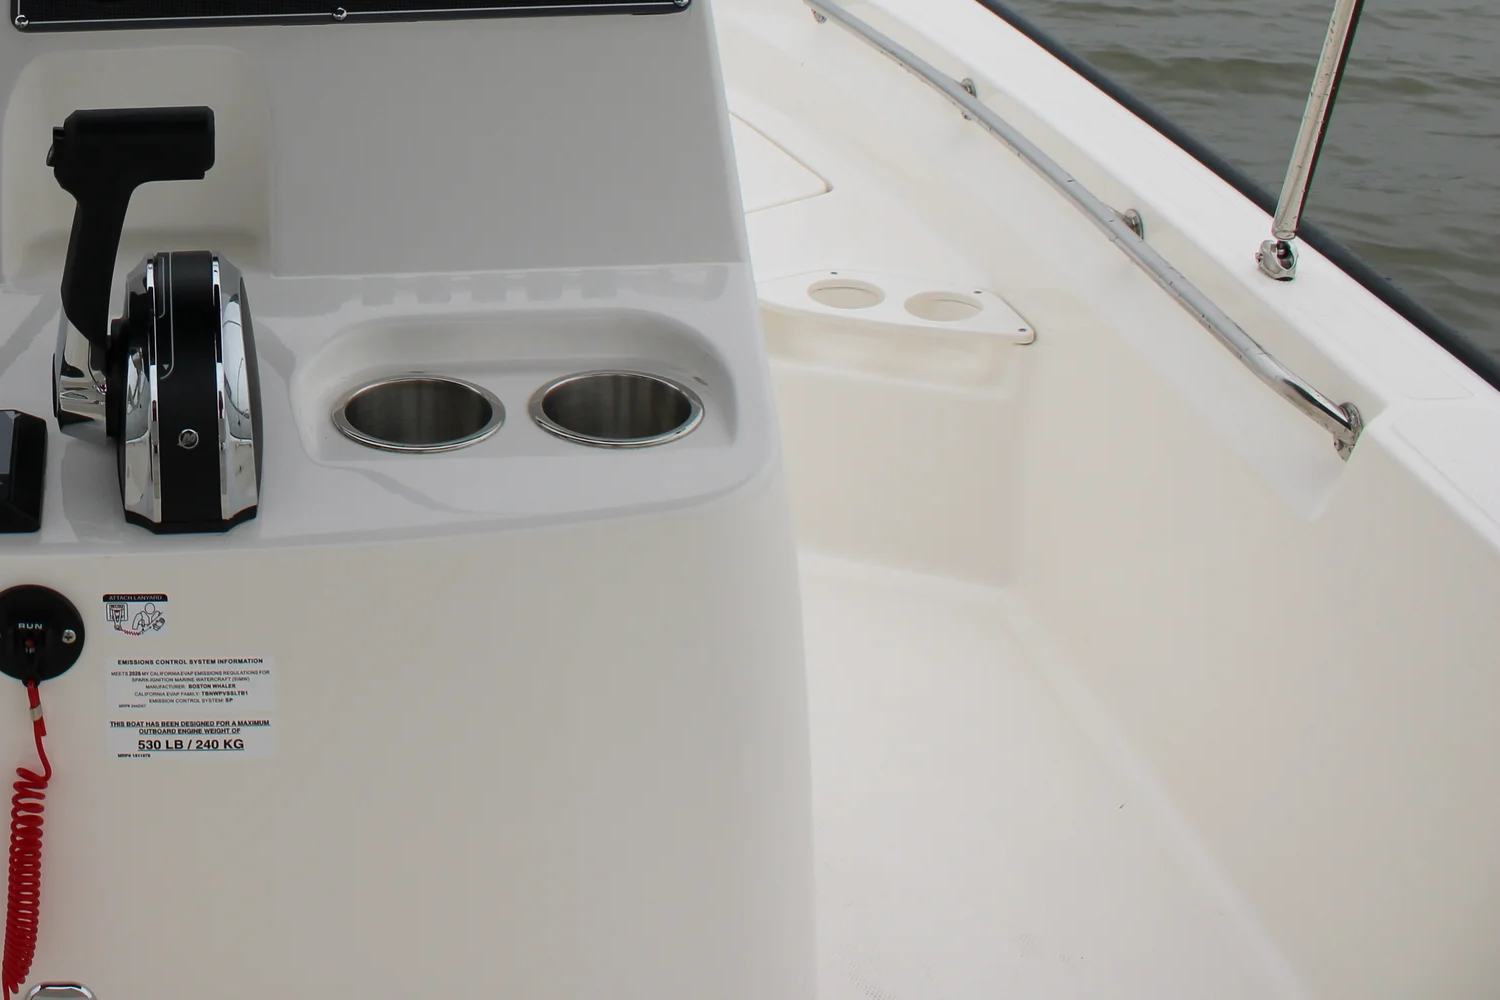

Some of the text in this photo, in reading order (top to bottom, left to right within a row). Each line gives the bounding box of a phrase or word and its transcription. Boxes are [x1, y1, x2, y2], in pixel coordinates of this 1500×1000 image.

[138, 740, 161, 750] 530
[166, 739, 183, 749] LB
[196, 739, 219, 749] 240
[224, 739, 244, 749] KG
